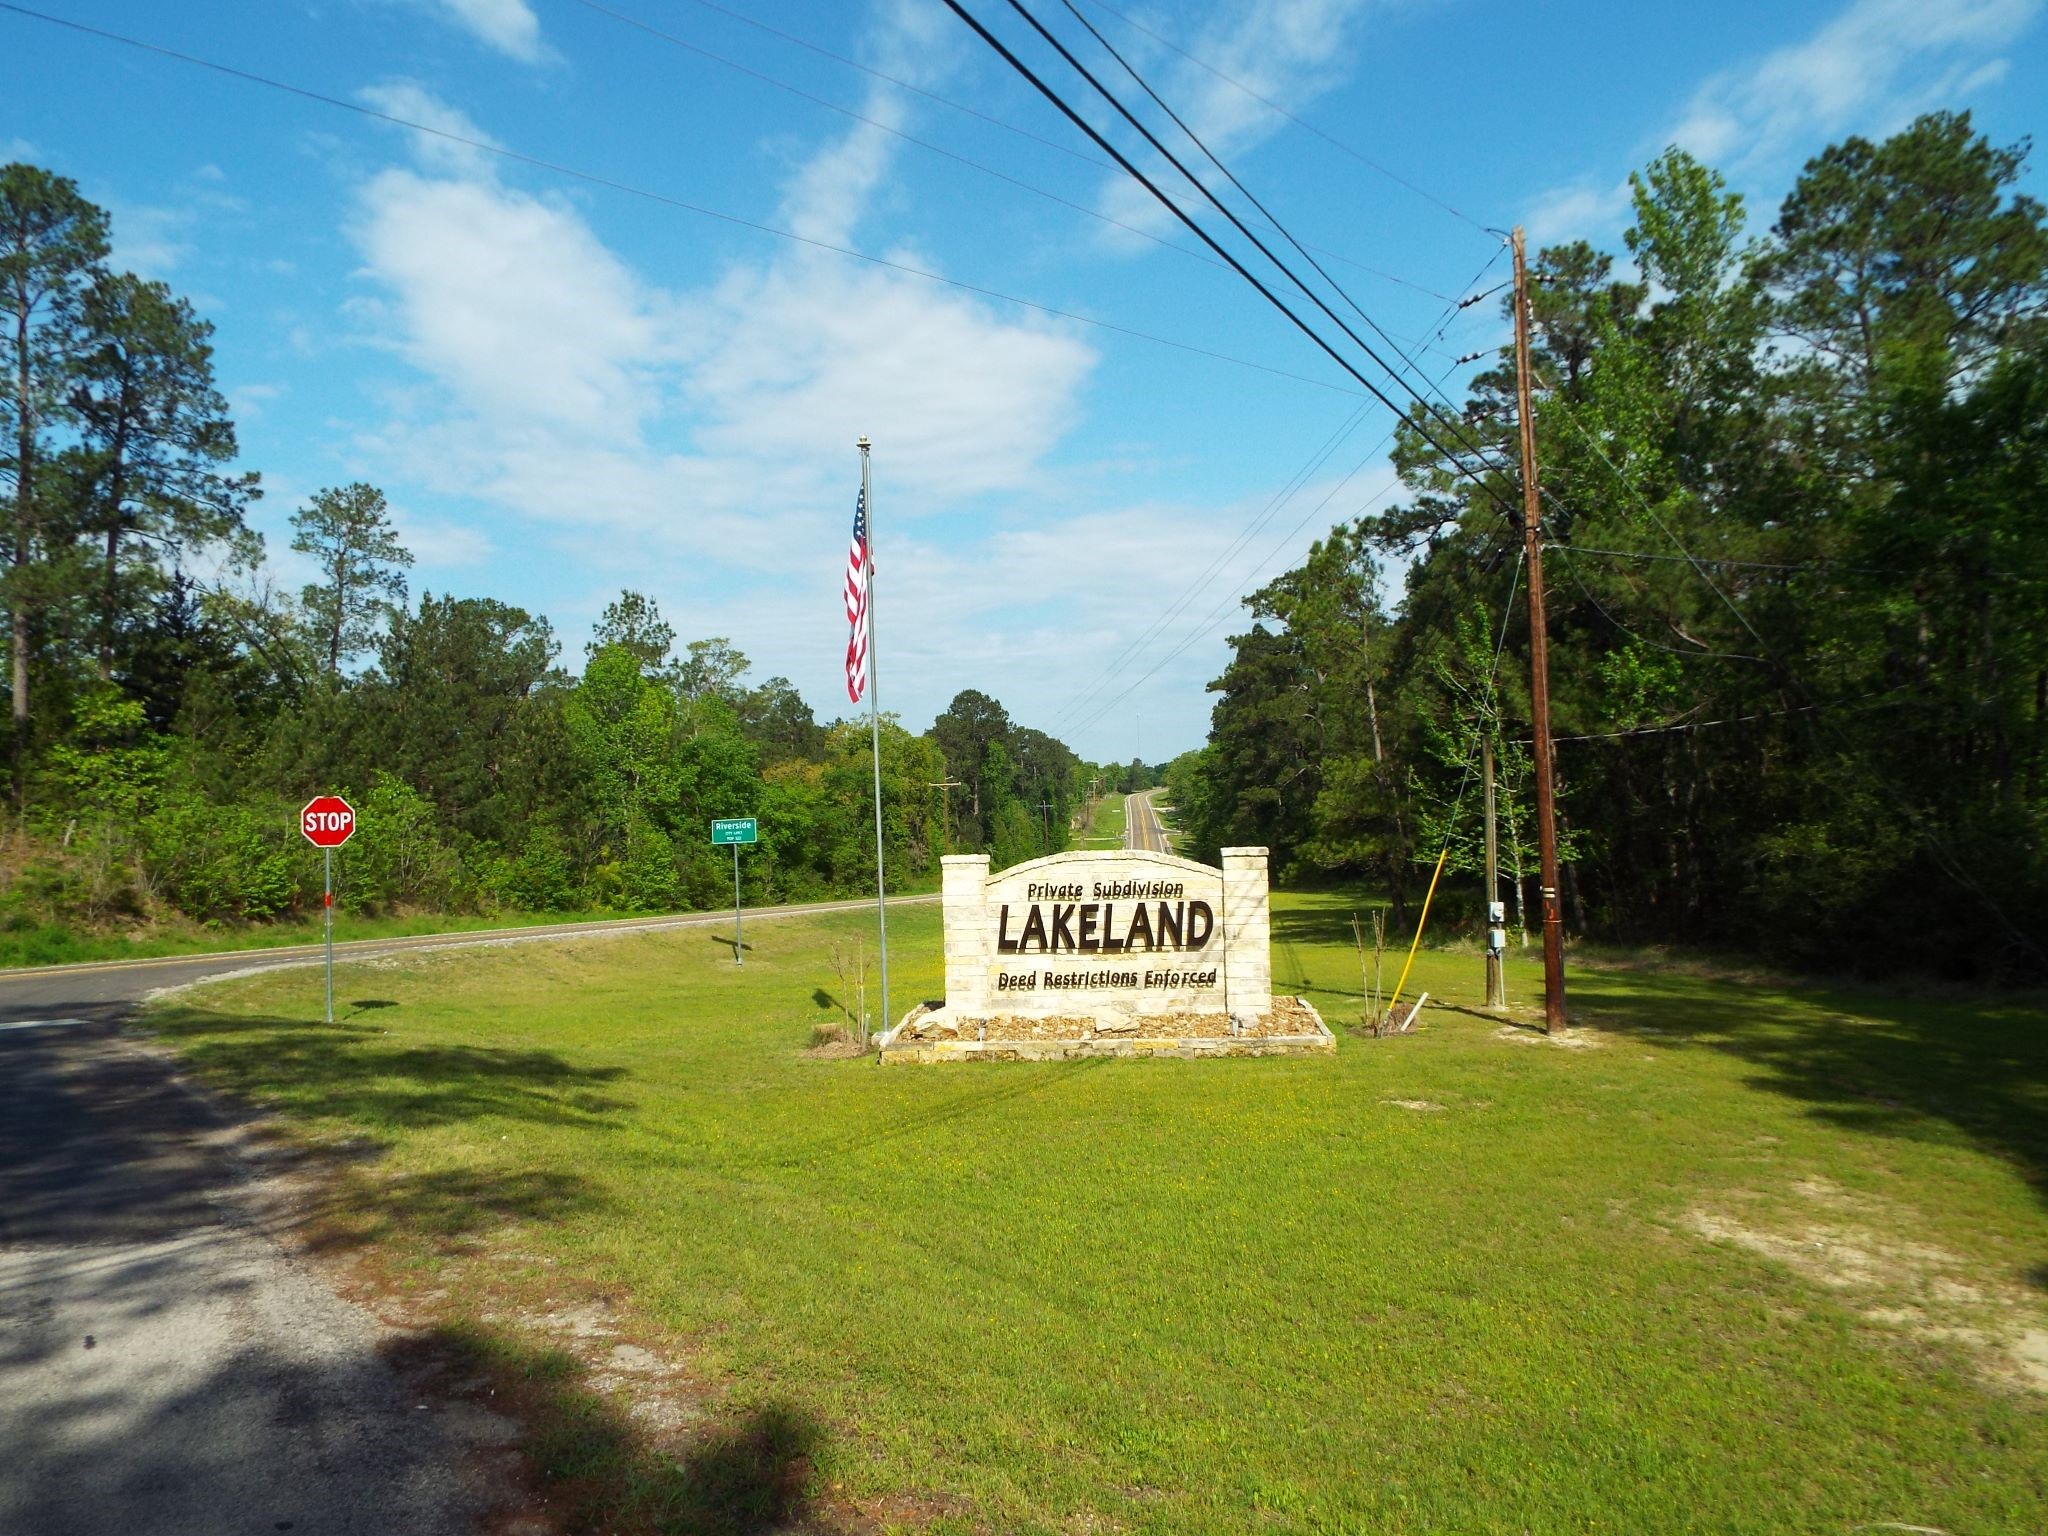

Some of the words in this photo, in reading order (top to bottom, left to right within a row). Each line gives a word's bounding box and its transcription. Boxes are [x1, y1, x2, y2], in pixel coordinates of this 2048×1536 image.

[305, 812, 352, 832] STOP
[715, 821, 751, 830] Riverside
[1028, 883, 1083, 899] Private
[1093, 881, 1183, 899] Subdivision
[998, 901, 1213, 951] LAKELAND
[999, 971, 1036, 988] Deed
[1044, 970, 1138, 988] Restrictions
[1145, 968, 1217, 989] Enforced
